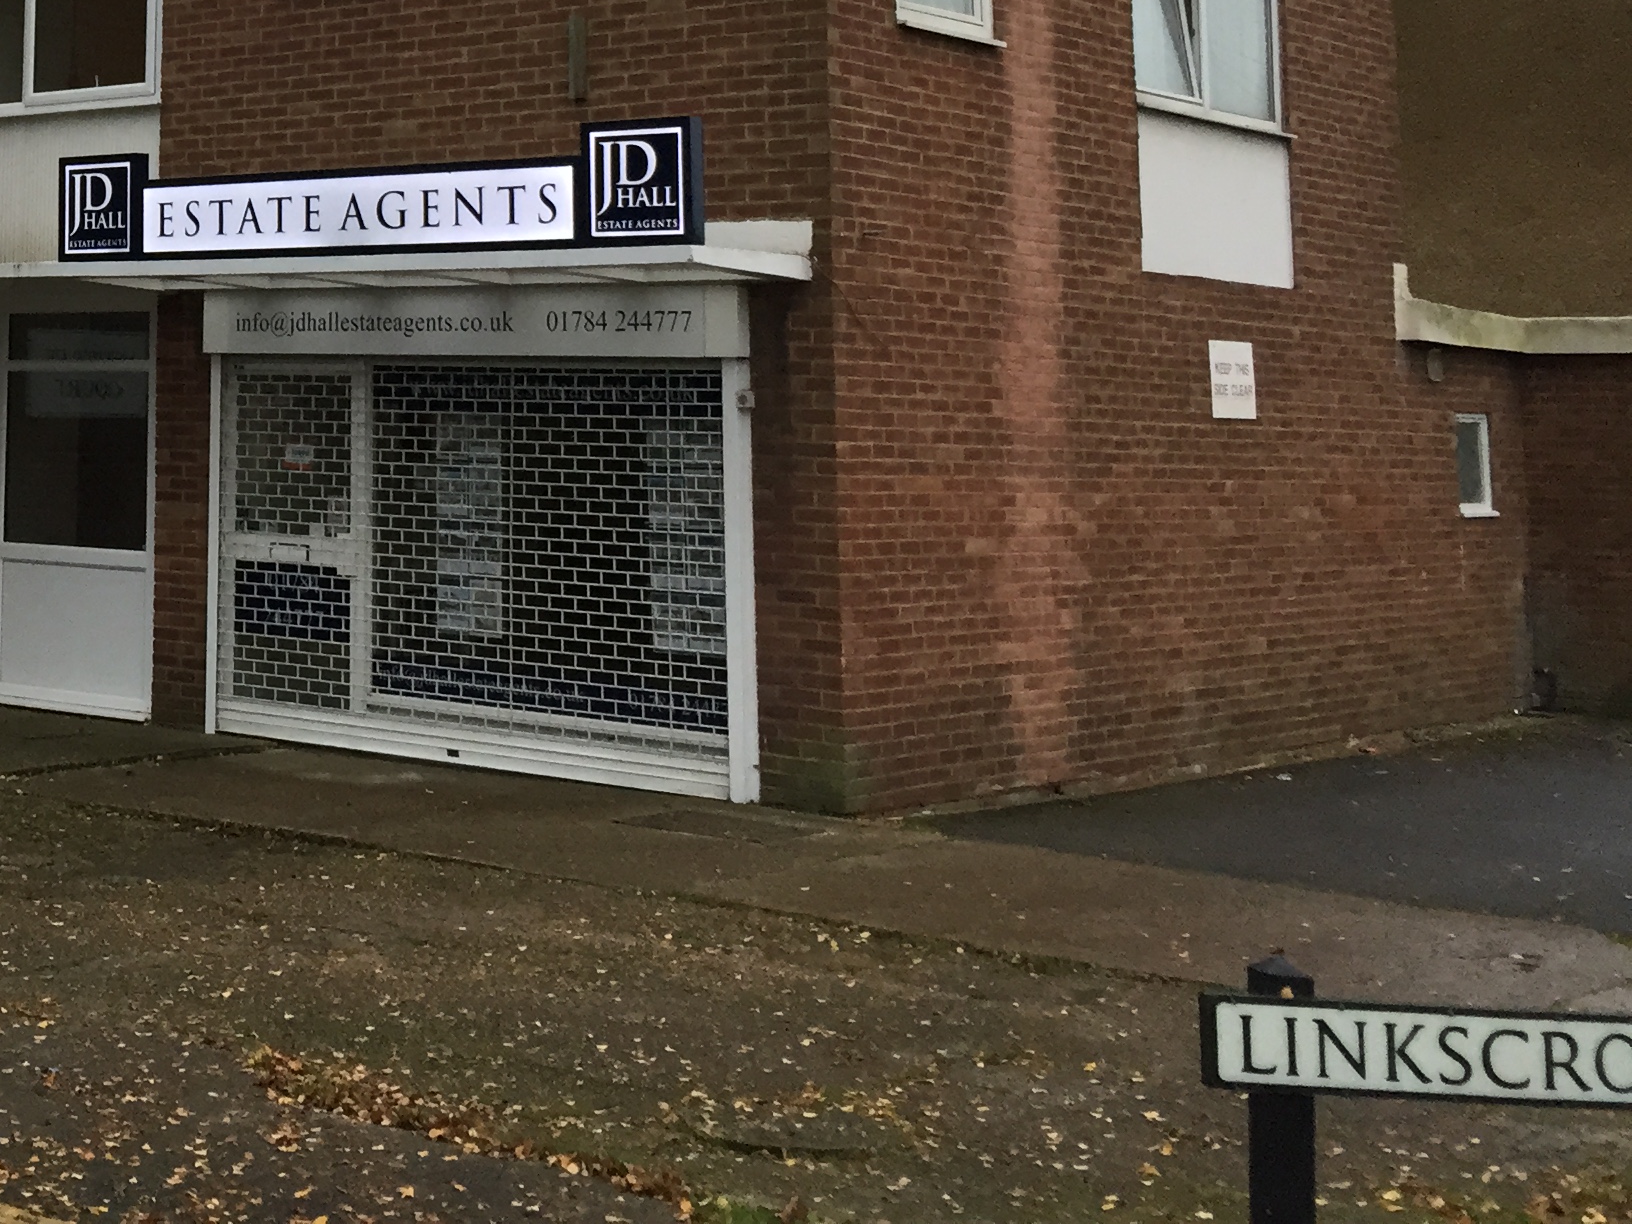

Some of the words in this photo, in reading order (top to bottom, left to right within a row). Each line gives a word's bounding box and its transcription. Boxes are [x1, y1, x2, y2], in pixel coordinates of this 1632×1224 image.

[597, 140, 657, 216] JD
[70, 172, 112, 237] JD
[616, 185, 677, 208] HALL
[84, 211, 126, 230] HALL
[156, 194, 322, 238] ESTATE
[340, 182, 558, 232] AGENTS
[597, 219, 633, 230] ESTATE
[635, 218, 678, 229] AGENTS
[69, 239, 95, 248] ESTATE
[97, 238, 127, 247] AGENTS
[235, 311, 514, 338] info@jdhallestateagents.co.uk
[546, 310, 608, 334] 01784
[614, 309, 693, 333] 244777
[1214, 383, 1229, 396] SIDE
[1239, 1014, 1632, 1094] LINKSCRO
